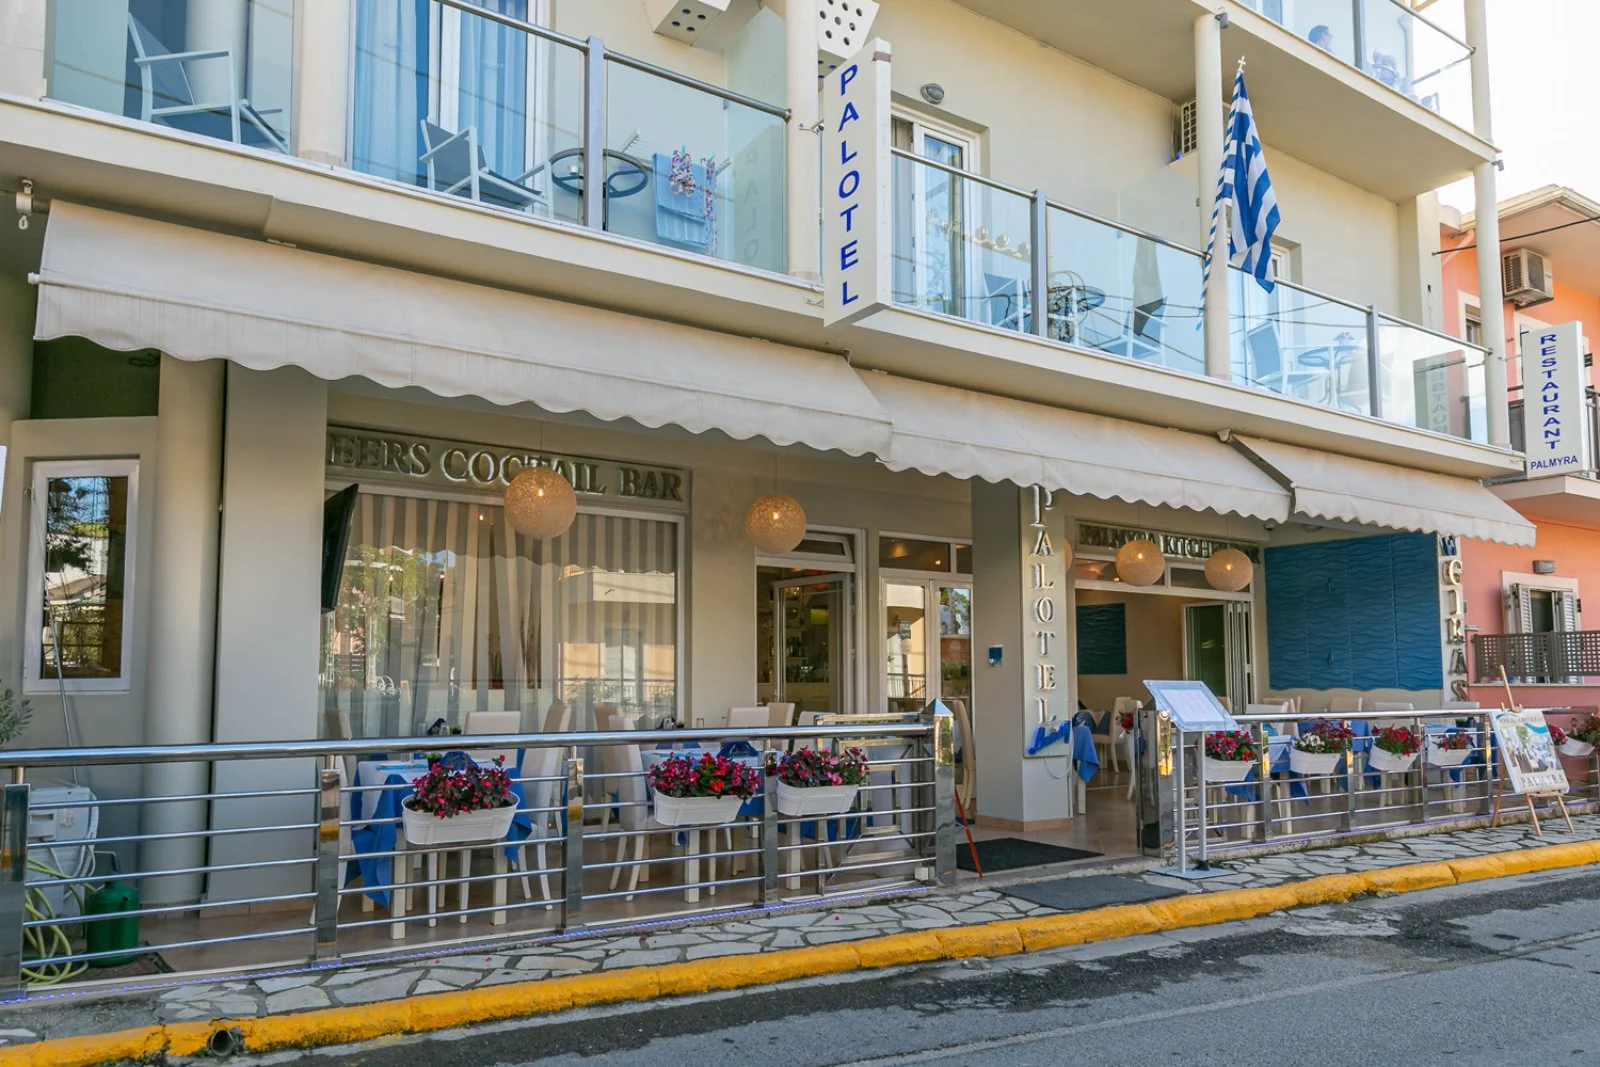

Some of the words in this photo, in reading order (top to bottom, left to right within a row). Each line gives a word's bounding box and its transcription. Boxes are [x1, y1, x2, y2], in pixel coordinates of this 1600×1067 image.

[838, 64, 860, 306] PALOTEL
[1540, 334, 1561, 450] RESTAURANT
[327, 433, 432, 478] EERS
[440, 448, 608, 496] COCAIL
[619, 466, 684, 503] BAR
[1530, 455, 1578, 470] PALMYRA
[1029, 483, 1058, 727] PALOTEL
